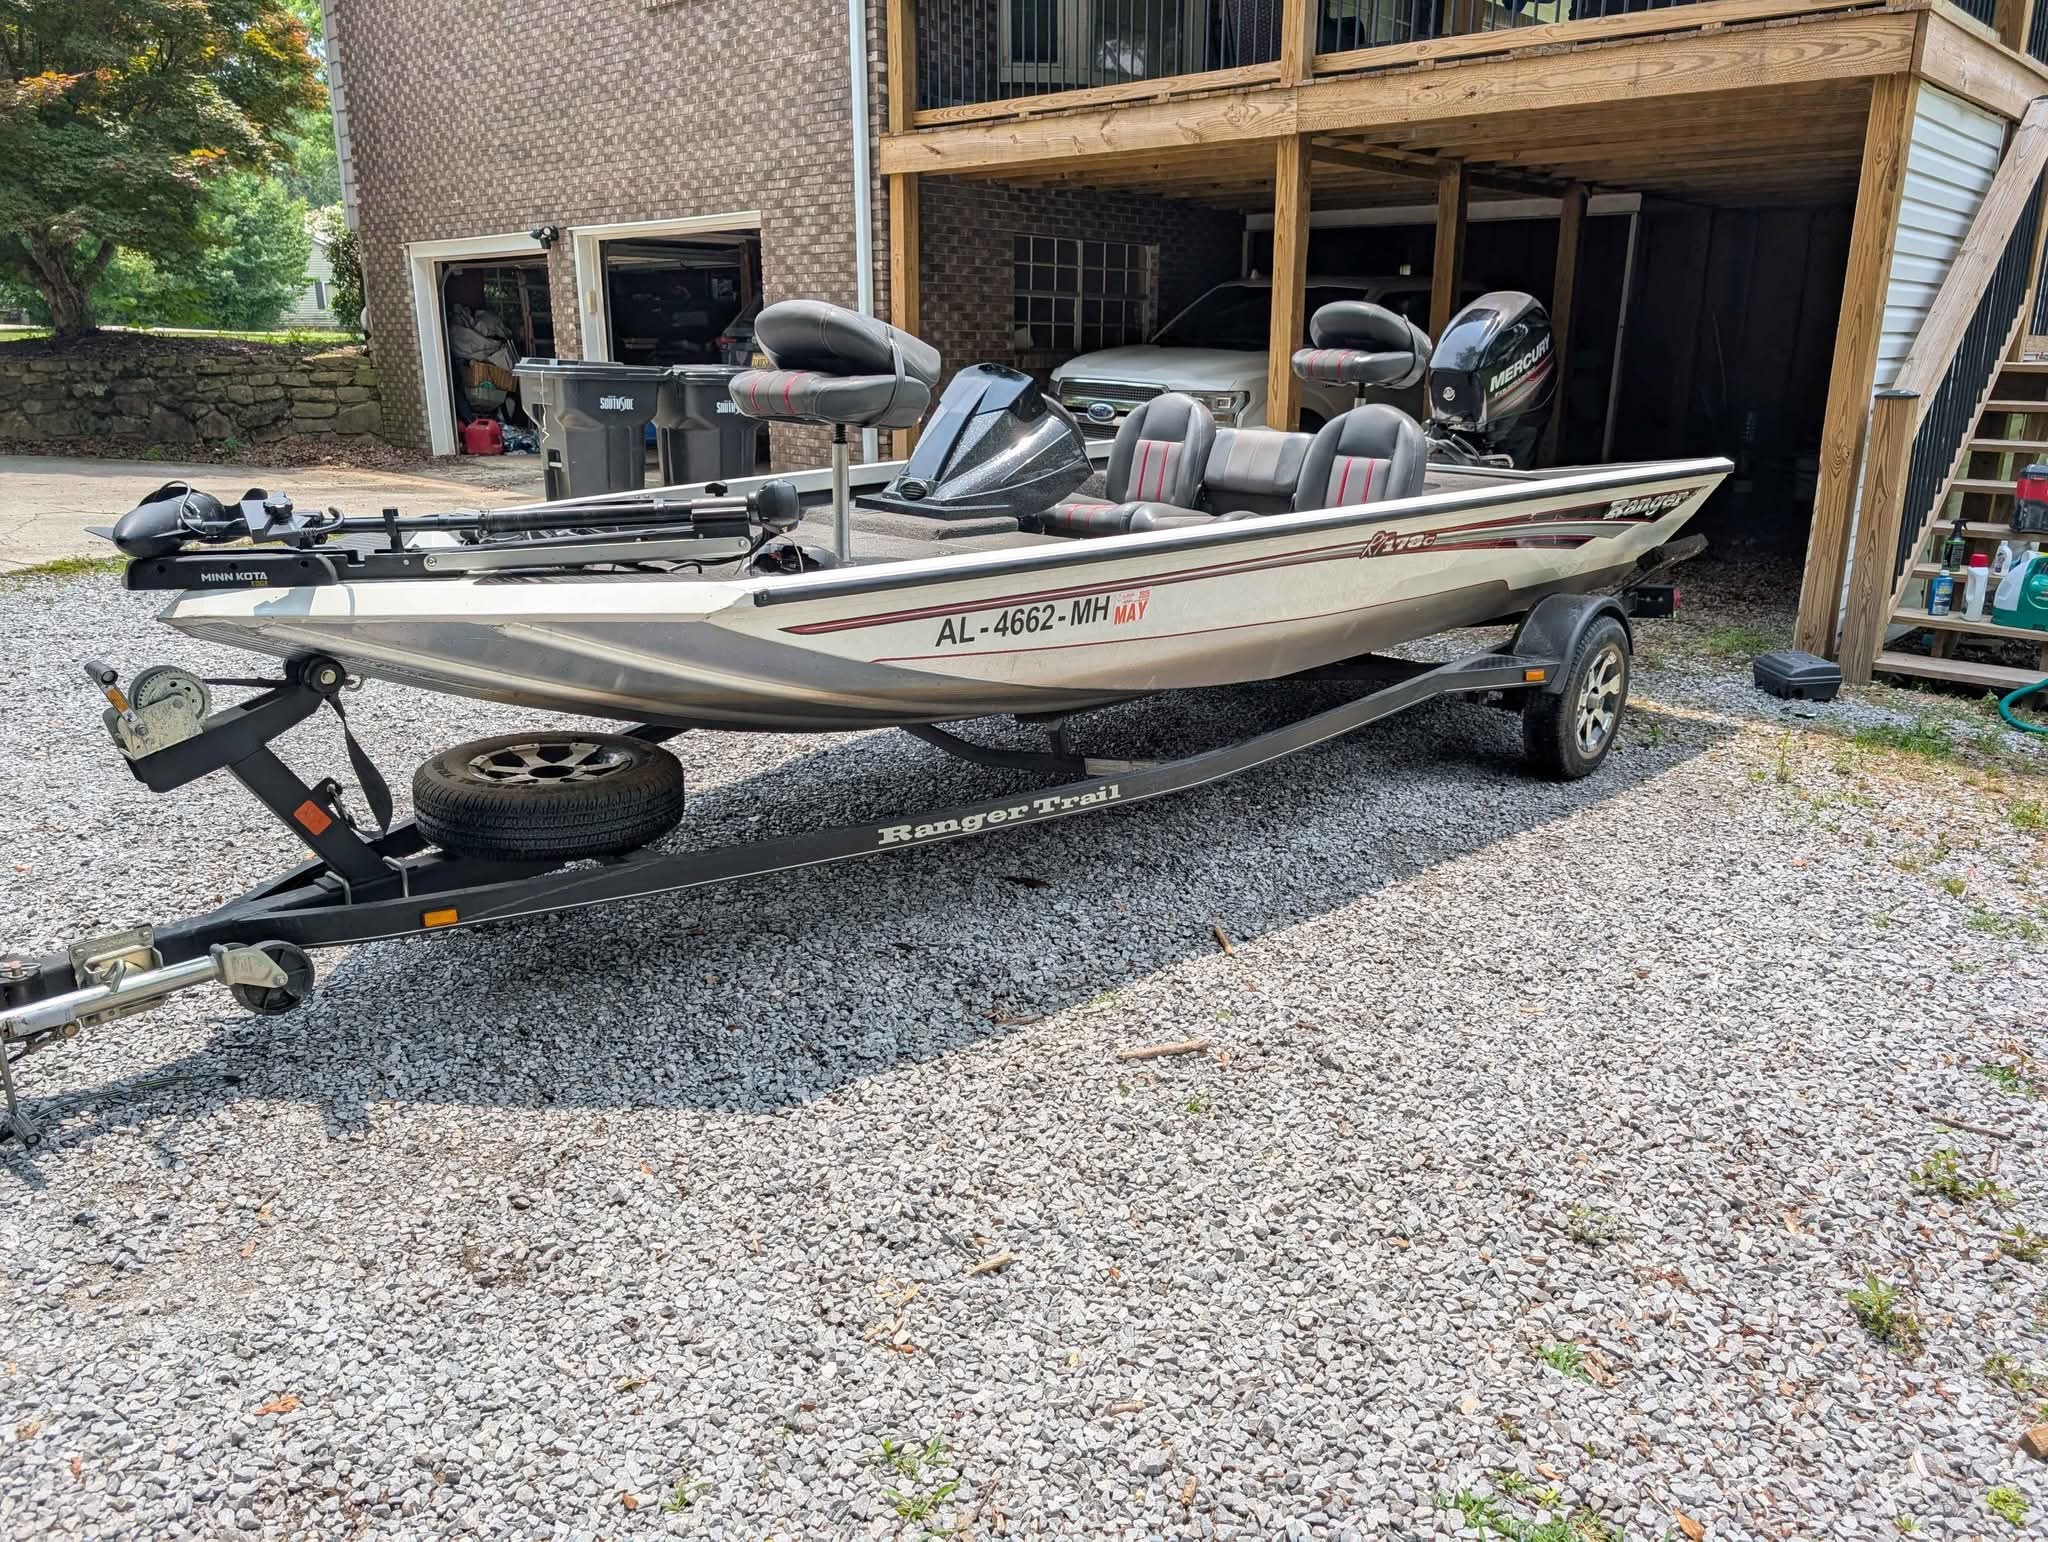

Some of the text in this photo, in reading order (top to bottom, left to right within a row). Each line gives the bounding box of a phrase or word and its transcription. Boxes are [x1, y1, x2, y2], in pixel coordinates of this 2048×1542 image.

[1489, 332, 1550, 393] MERCURY
[1603, 491, 1690, 520] Ranger
[201, 571, 268, 582] MINN KOTA
[1113, 600, 1149, 625] MAY
[878, 784, 1121, 845] Ranger Trail
